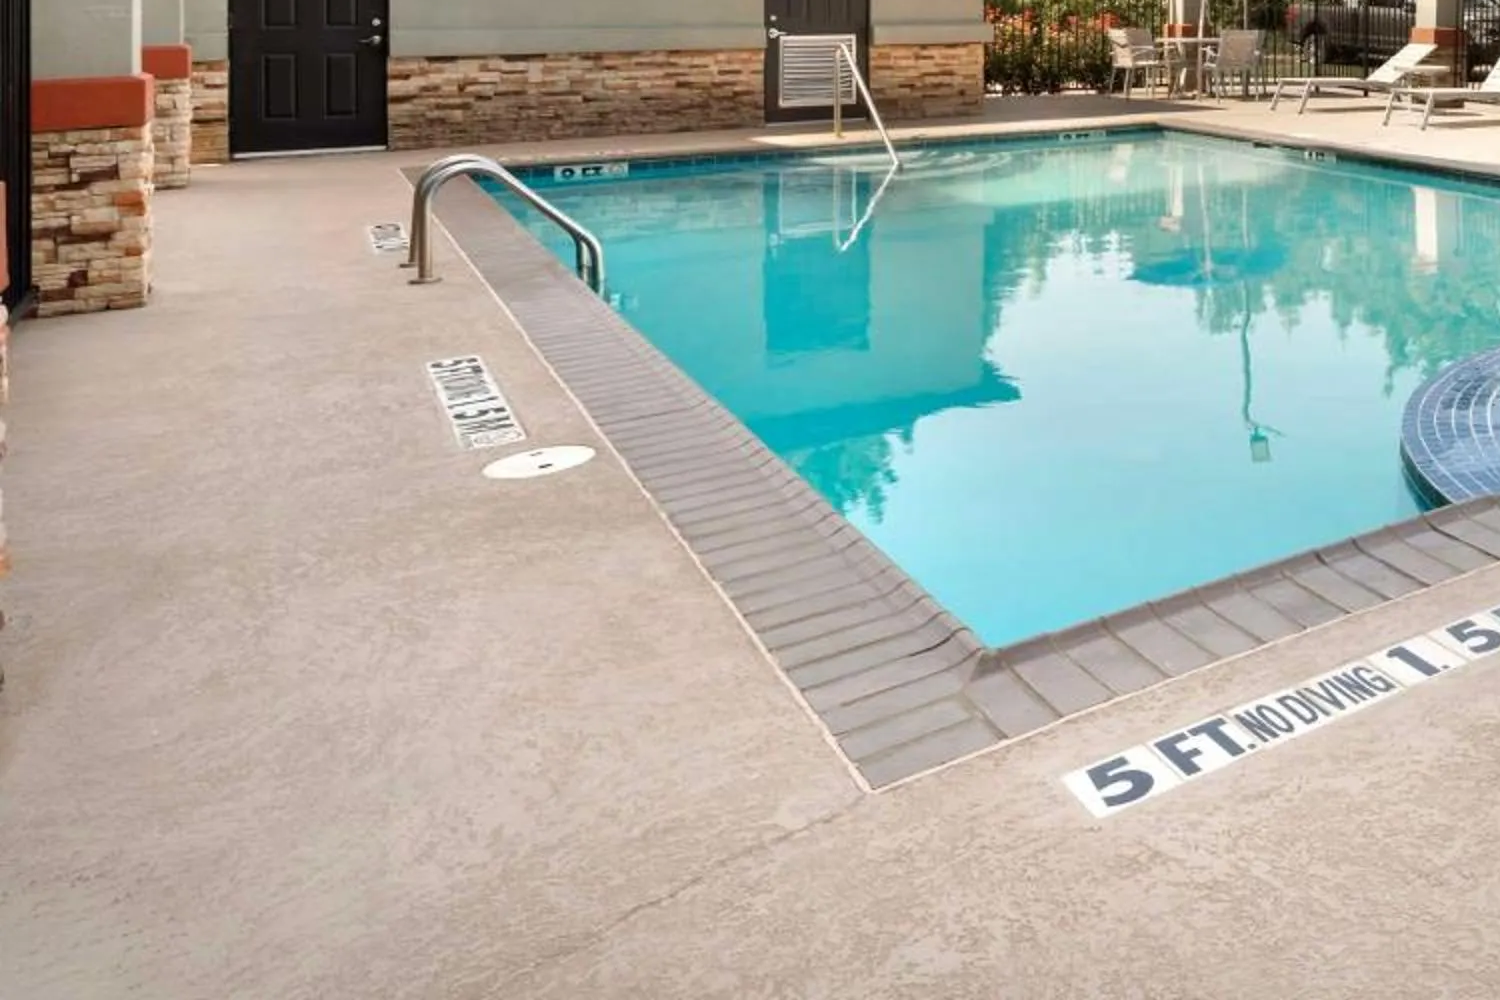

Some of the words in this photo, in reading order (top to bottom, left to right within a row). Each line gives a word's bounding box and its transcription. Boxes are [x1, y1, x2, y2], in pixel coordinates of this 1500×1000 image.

[1086, 756, 1155, 808] 5
[1233, 703, 1294, 743] NO
[1282, 665, 1396, 725] DIVING
